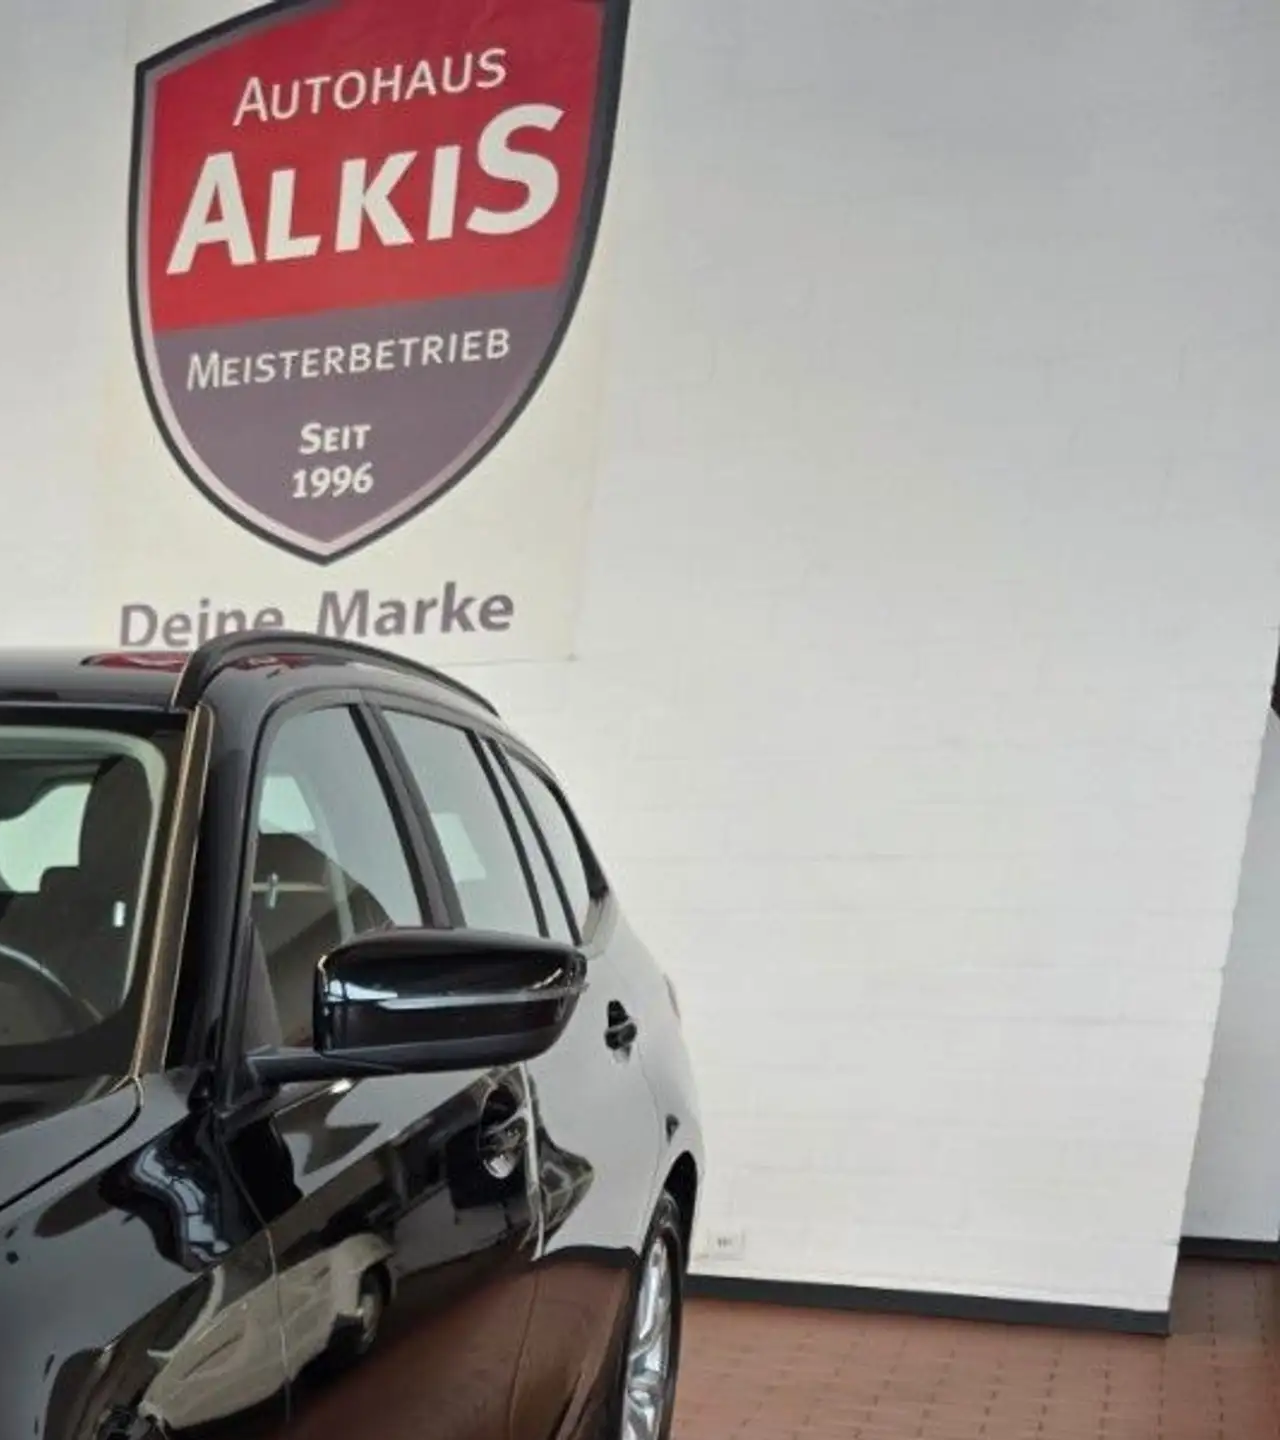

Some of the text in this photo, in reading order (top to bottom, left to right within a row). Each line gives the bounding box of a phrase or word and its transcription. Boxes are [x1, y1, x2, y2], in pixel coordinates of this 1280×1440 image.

[233, 47, 506, 126] AUTOHAUS
[186, 328, 510, 391] MEISTERBETRIEB
[291, 462, 374, 498] 1996
[120, 581, 514, 648] Deine Marke
